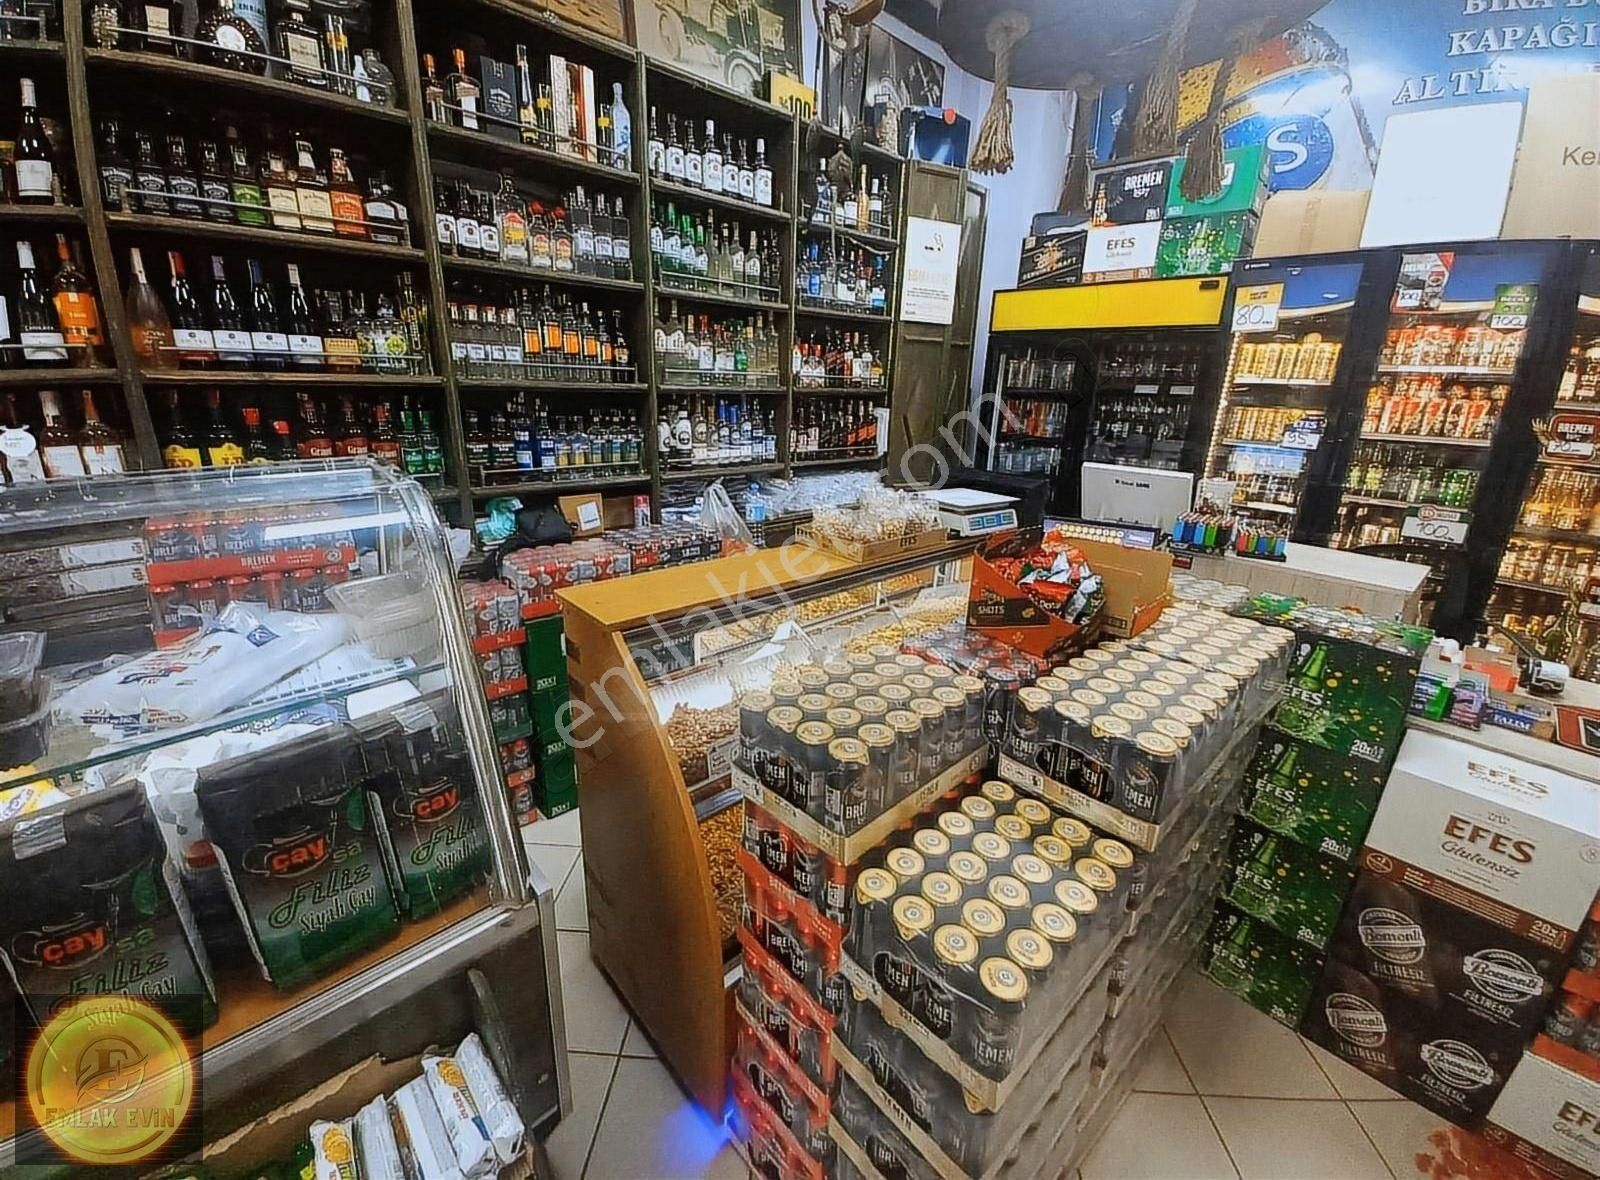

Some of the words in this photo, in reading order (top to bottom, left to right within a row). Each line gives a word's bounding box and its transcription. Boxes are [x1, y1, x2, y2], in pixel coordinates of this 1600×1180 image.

[1562, 146, 1600, 166] Ke
[1124, 170, 1164, 191] BREMEN
[1106, 236, 1136, 250] EFES
[1237, 304, 1265, 325] 80
[1282, 686, 1324, 706] EFES
[1255, 778, 1296, 803] EFES
[1444, 815, 1536, 863] EFES
[1441, 840, 1521, 879] Glutensiz
[1235, 865, 1273, 890] EFES
[268, 864, 371, 929] Filiz
[301, 894, 347, 935] Siyah
[348, 885, 376, 916] Çay
[1212, 943, 1248, 970] EFES
[1469, 961, 1538, 988] Bomonti
